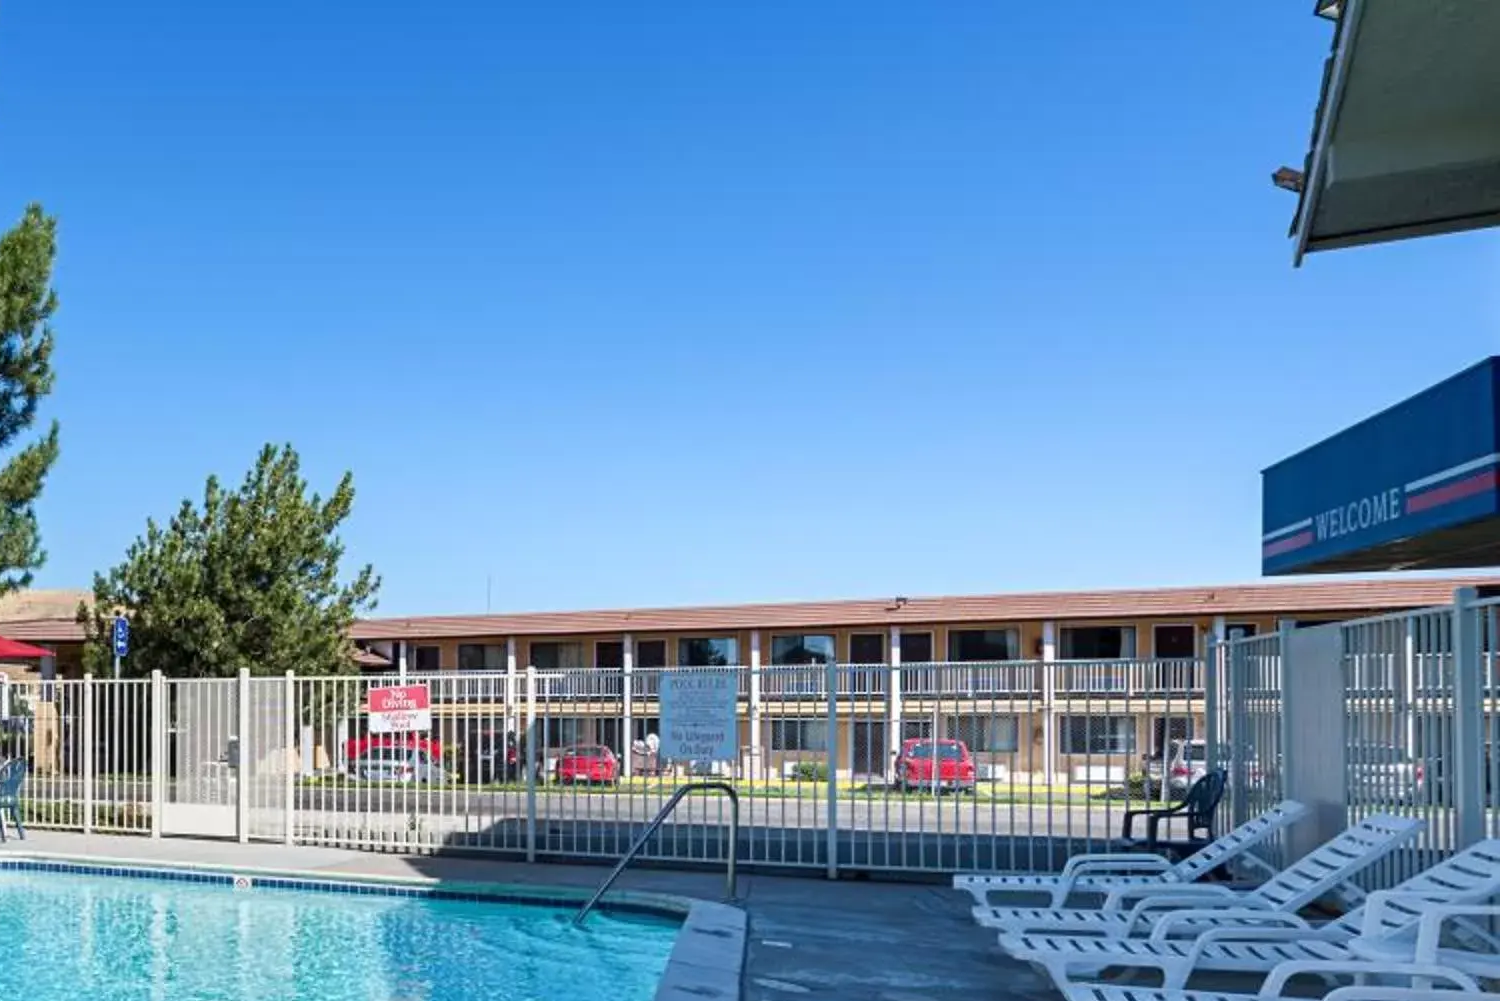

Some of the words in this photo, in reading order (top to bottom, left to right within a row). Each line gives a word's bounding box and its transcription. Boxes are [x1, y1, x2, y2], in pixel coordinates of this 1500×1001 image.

[1315, 487, 1400, 541] WELCOME
[389, 688, 407, 699] No
[381, 697, 417, 709] Diving
